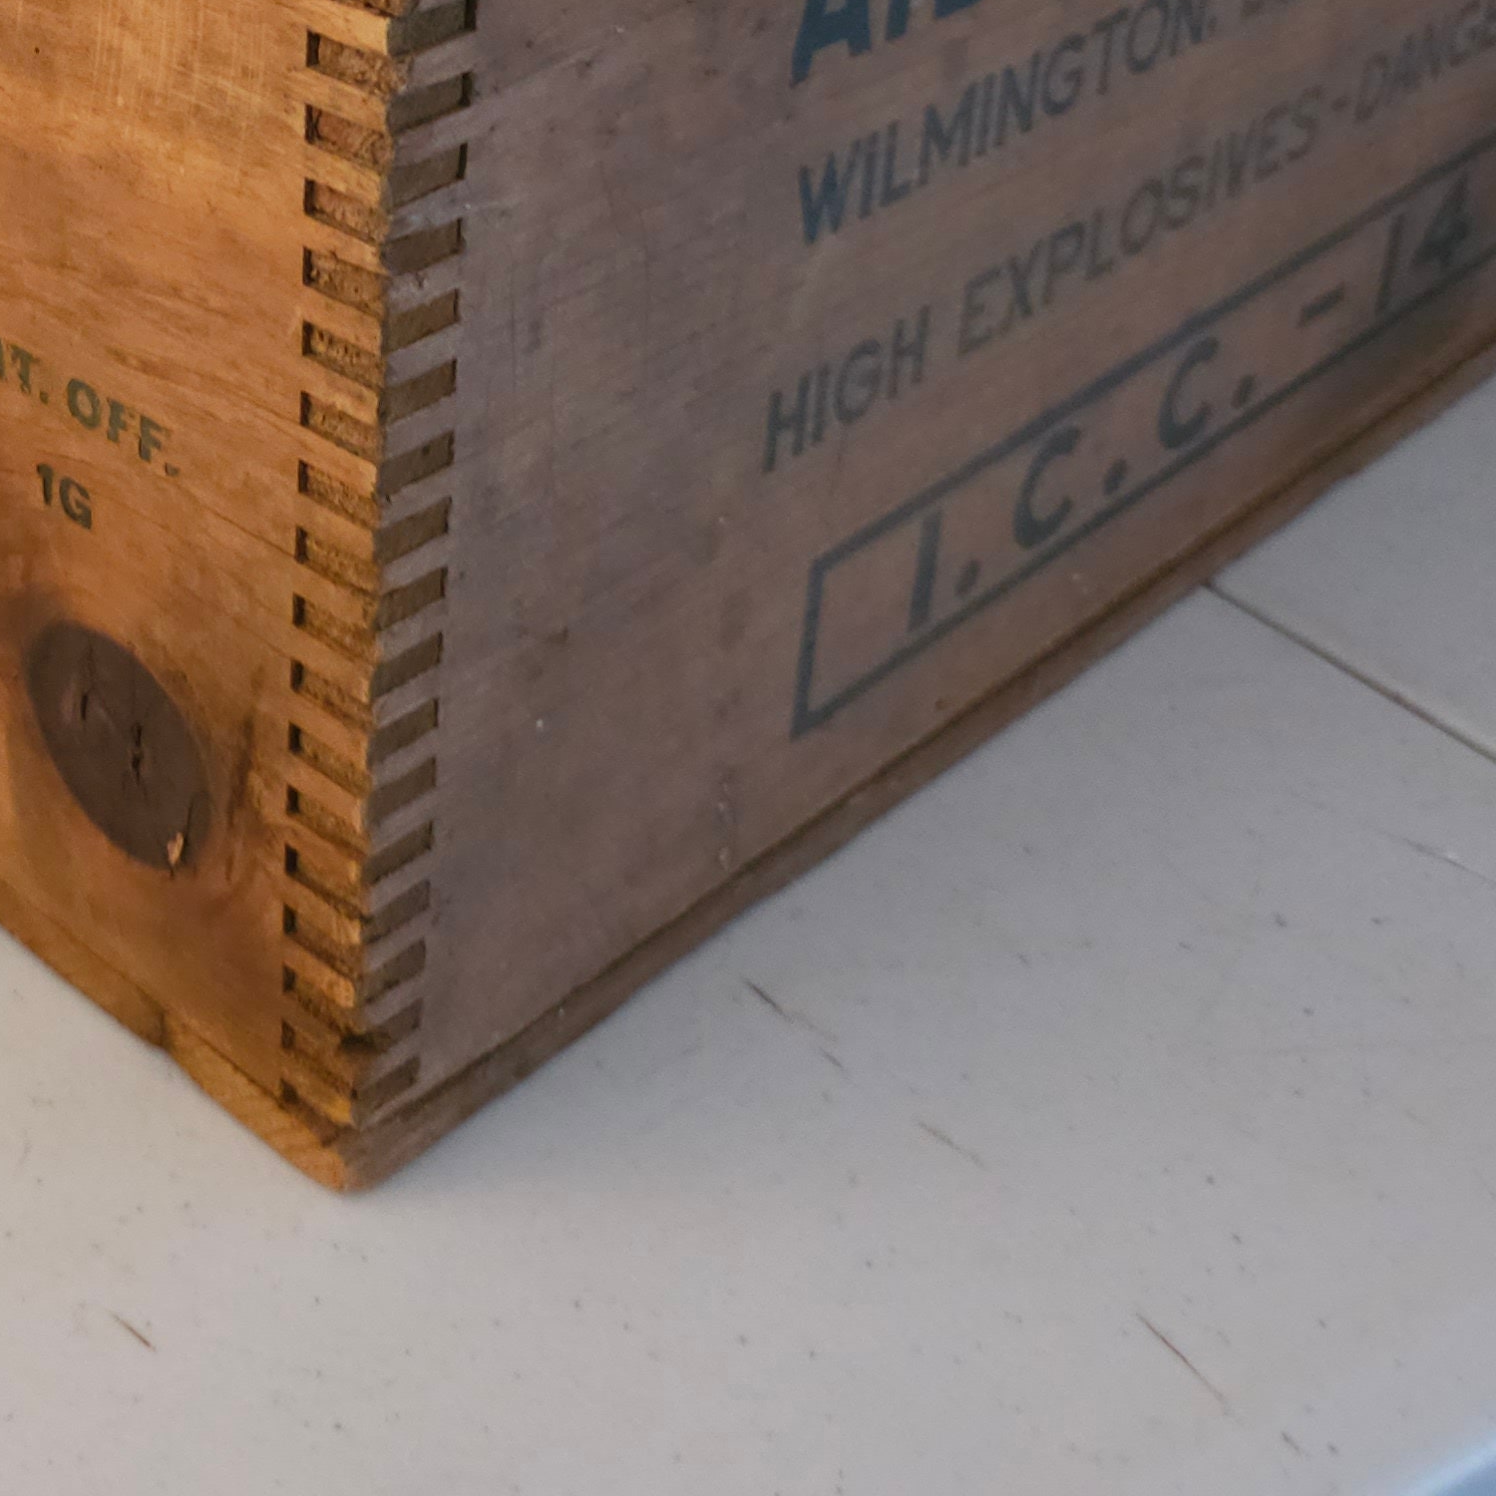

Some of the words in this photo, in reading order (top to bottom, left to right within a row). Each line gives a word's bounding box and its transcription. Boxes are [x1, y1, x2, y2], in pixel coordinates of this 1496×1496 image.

[67, 378, 180, 477] OFF.
[763, 304, 931, 474] HIGH
[36, 463, 93, 530] 1G
